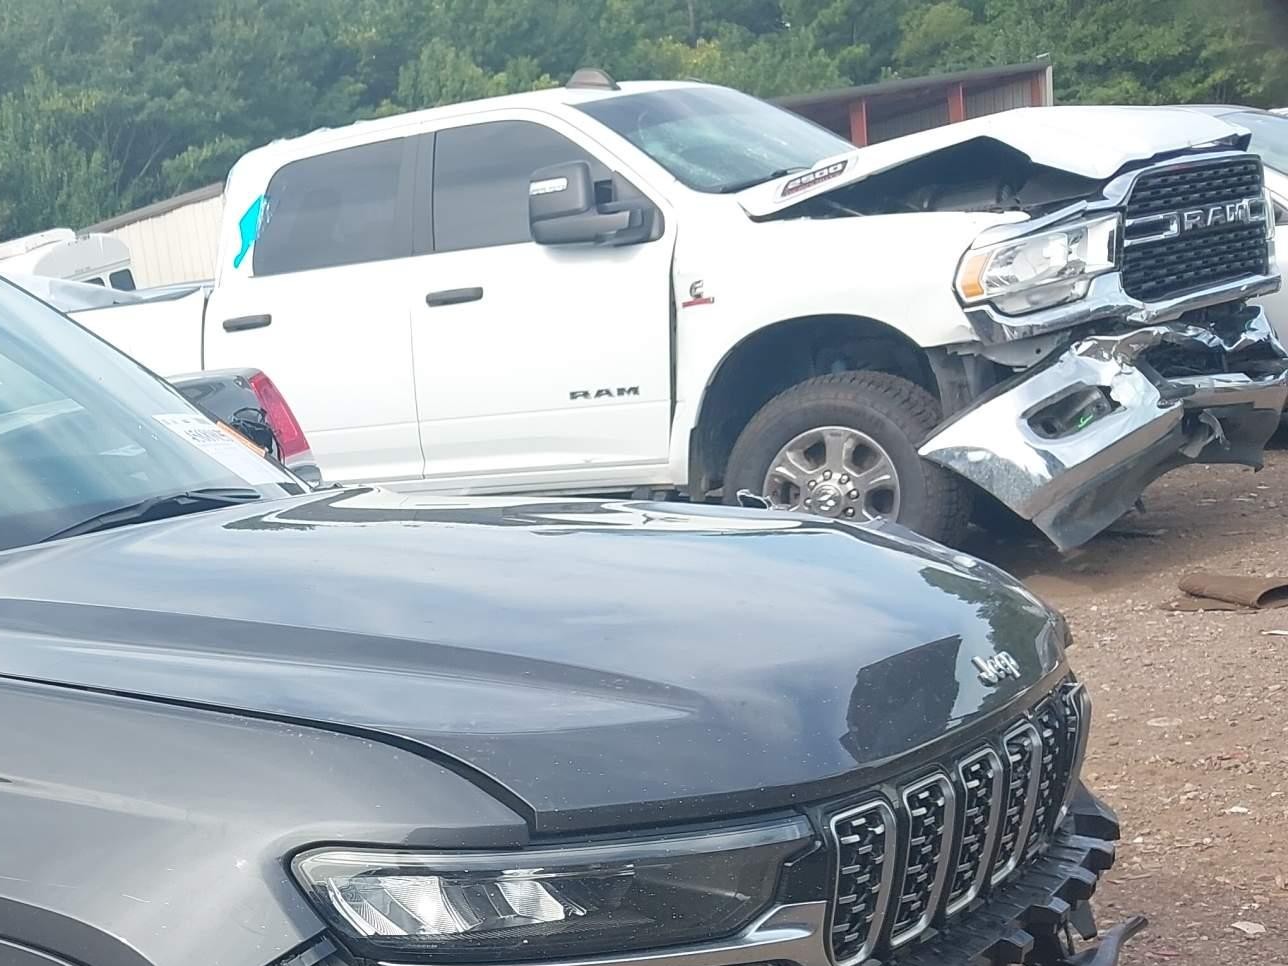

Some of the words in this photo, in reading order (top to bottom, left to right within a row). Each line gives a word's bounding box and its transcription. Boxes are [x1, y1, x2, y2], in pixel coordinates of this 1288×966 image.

[1183, 199, 1250, 231] RAM
[569, 386, 640, 401] RAM
[972, 652, 1021, 685] Jeep
